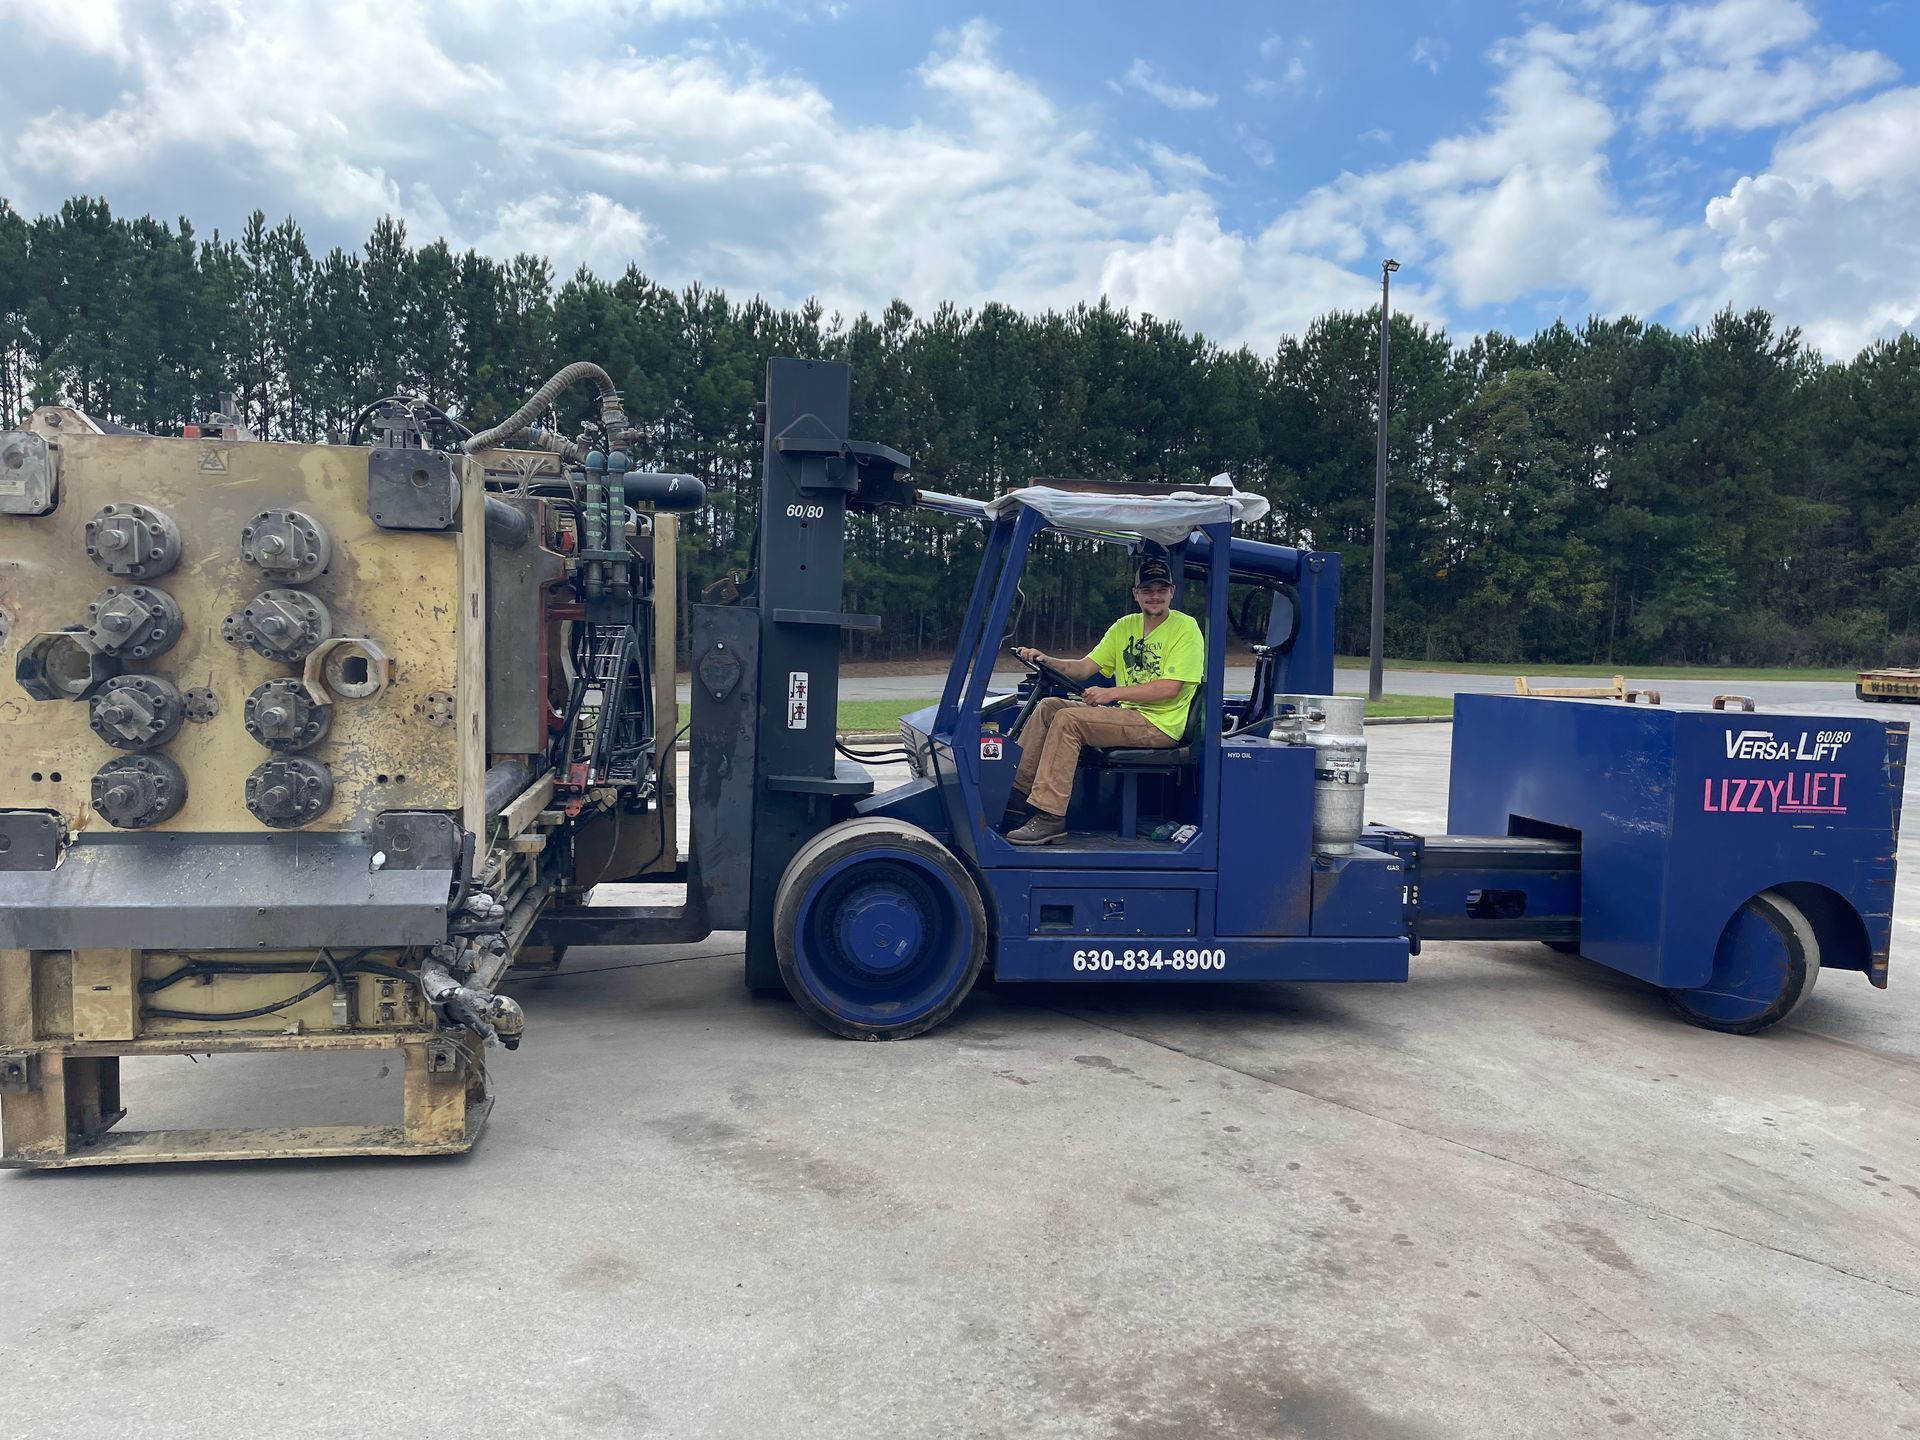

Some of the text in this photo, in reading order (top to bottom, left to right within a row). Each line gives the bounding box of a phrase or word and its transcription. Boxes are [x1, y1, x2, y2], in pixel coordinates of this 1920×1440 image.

[786, 504, 824, 519] 60/80
[1871, 682, 1900, 693] WIDE
[1816, 731, 1851, 744] 60/80
[1703, 771, 1847, 813] LIZZYLIFT
[1073, 949, 1226, 971] 630-834-8900
